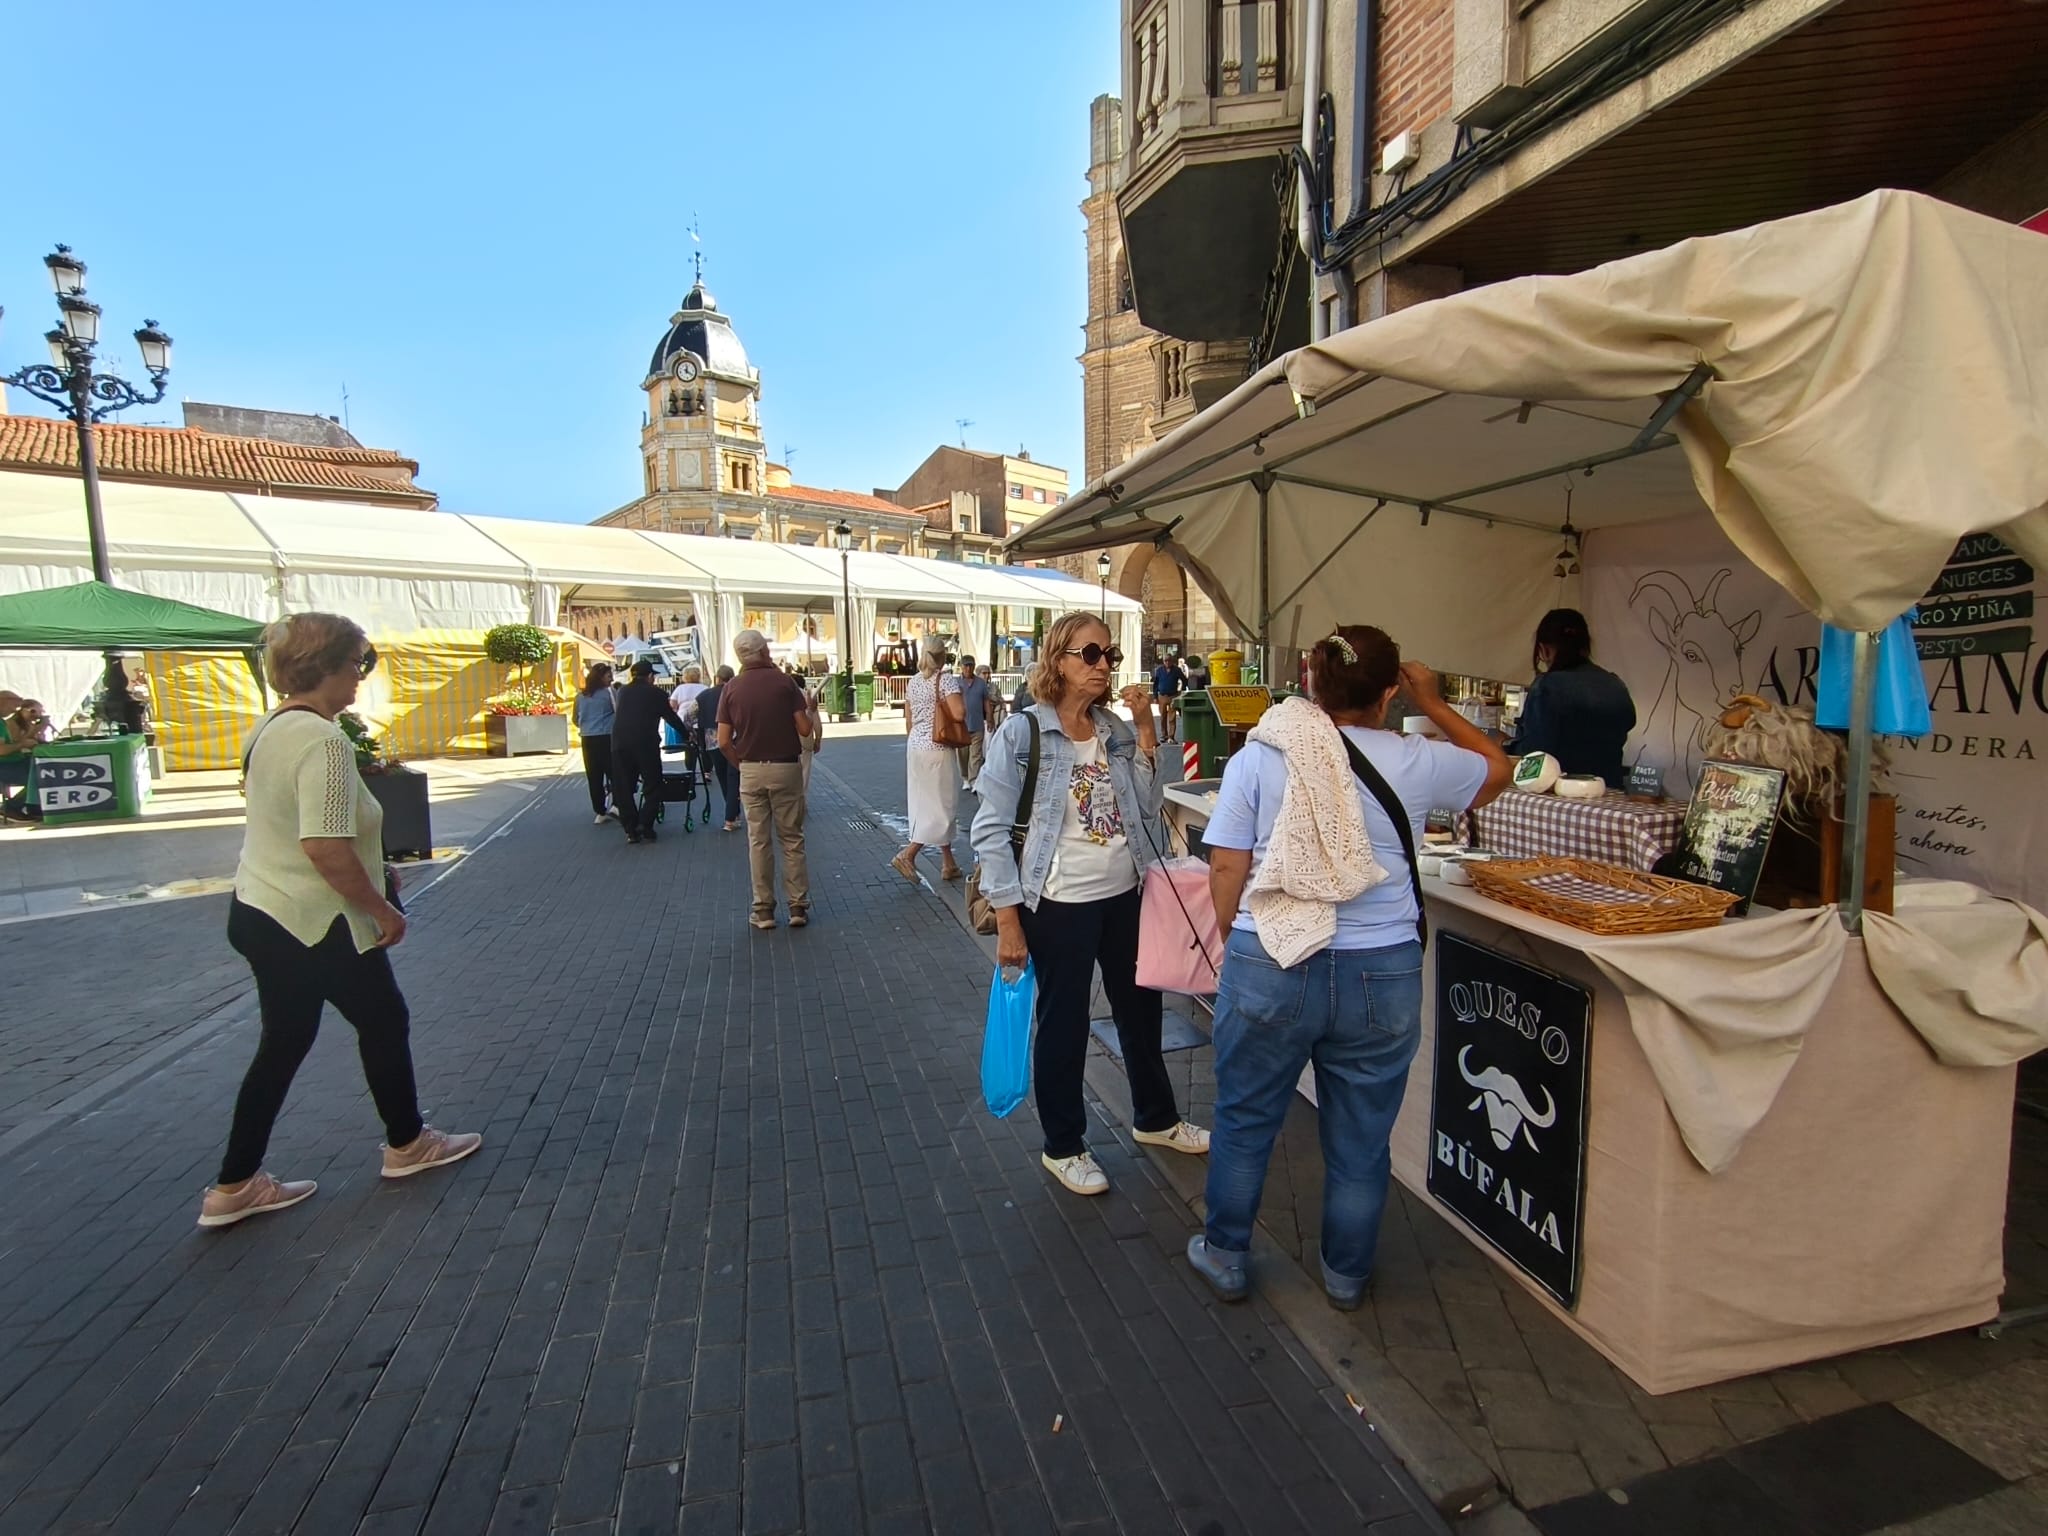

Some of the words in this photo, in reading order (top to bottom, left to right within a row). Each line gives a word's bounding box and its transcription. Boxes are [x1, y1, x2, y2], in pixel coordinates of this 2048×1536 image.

[1955, 537, 2012, 557] ANO
[1942, 566, 2016, 589] NUECES
[1949, 606, 1963, 622] Y
[1967, 600, 2016, 621] PIÑA
[1915, 804, 1987, 831] antes,
[1910, 829, 1977, 856] ahora
[1449, 980, 1570, 1065] QUESO
[1436, 1129, 1565, 1255] BÚFALA
